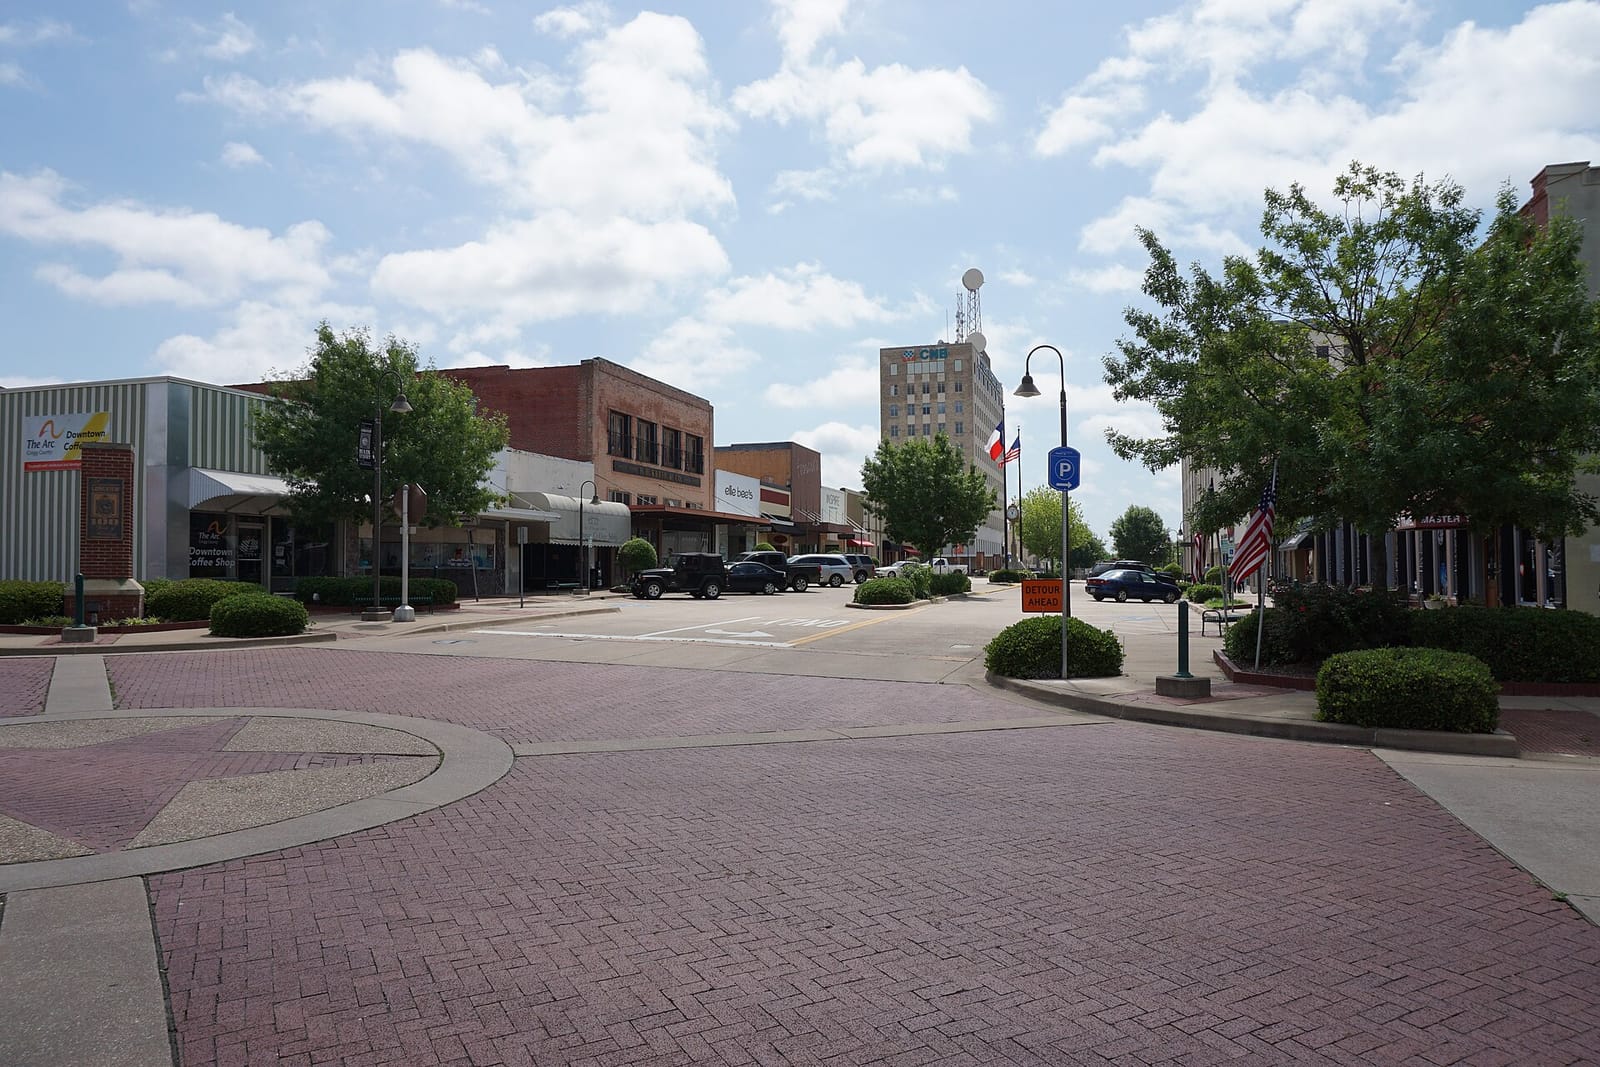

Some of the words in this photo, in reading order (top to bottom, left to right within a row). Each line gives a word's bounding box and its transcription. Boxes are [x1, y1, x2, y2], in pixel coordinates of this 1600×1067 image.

[919, 348, 948, 360] CNB
[66, 430, 106, 439] Downtown
[26, 439, 41, 449] The
[42, 439, 55, 449] Arc
[63, 441, 82, 451] Coffe
[1059, 462, 1071, 477] P
[724, 485, 736, 497] elle
[736, 487, 754, 500] bee's
[1420, 514, 1460, 524] MASTER
[199, 532, 210, 540] The
[210, 532, 220, 540] Arc
[189, 547, 233, 556] Downtown
[215, 557, 235, 568] Shop
[1025, 585, 1060, 594] DETOUR
[1028, 598, 1059, 606] AHEAD
